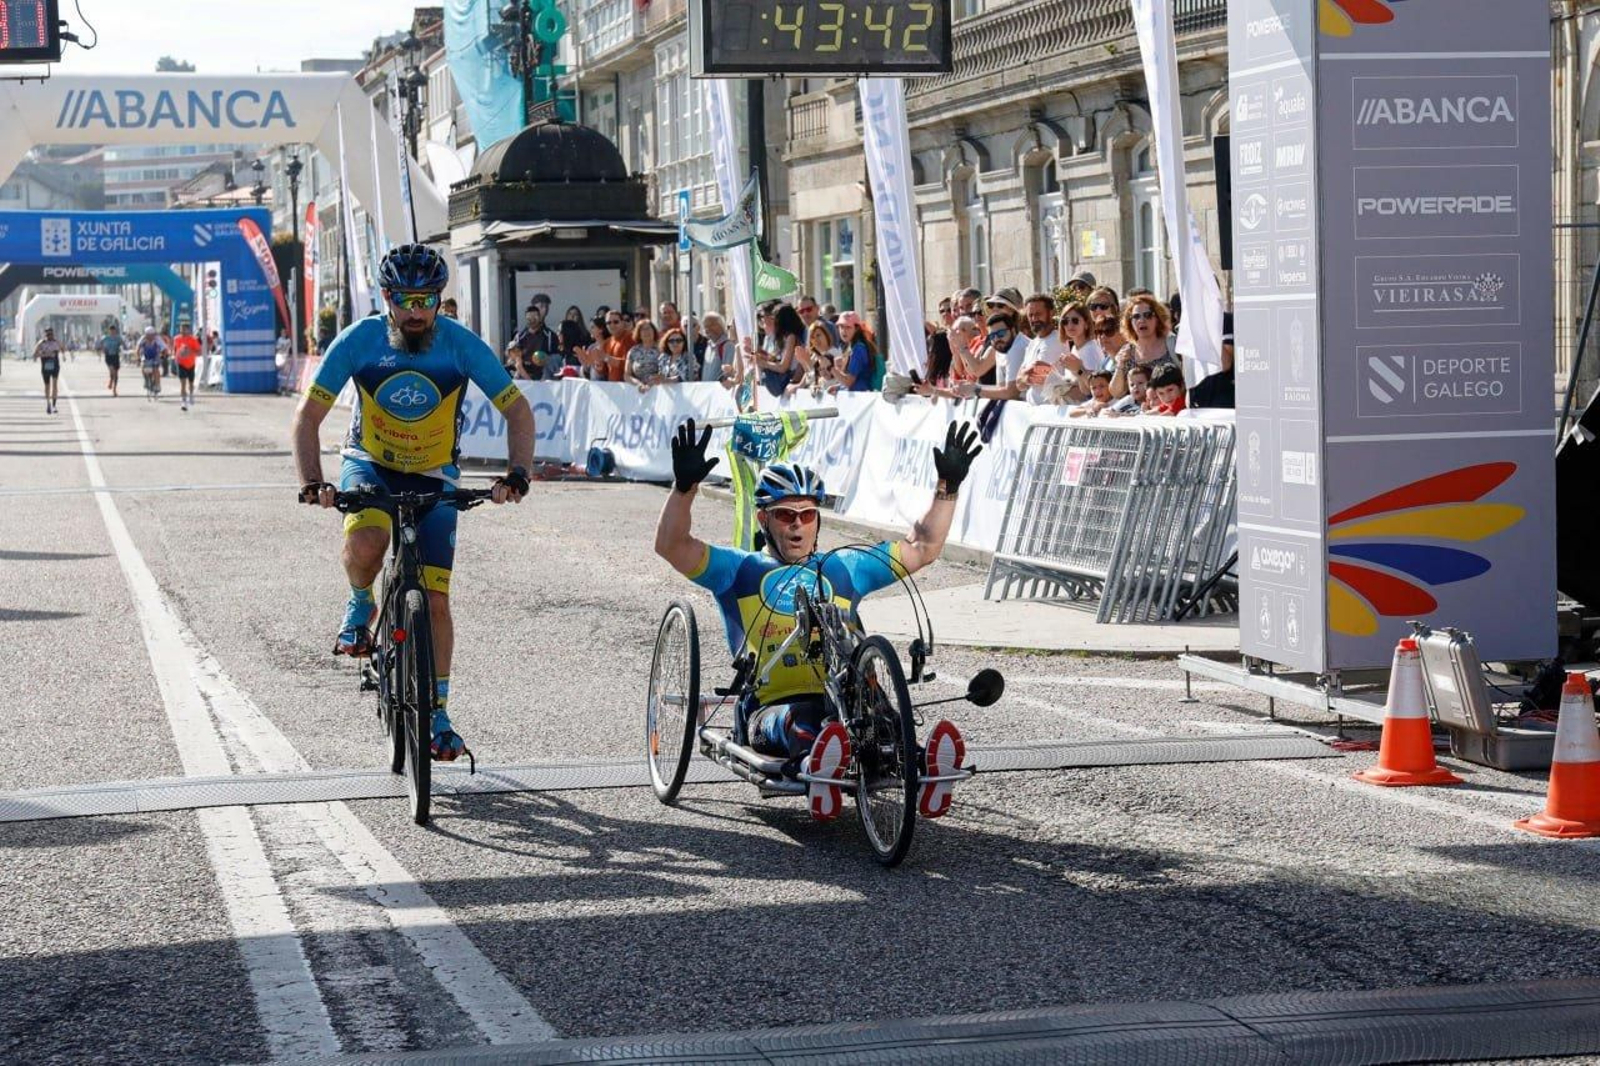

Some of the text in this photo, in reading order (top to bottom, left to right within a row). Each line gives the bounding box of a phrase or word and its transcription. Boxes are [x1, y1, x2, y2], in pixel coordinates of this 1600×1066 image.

[1358, 195, 1517, 216] POWERADE
[77, 221, 131, 235] XUNTA
[77, 236, 165, 251] DE GALICIA
[43, 266, 128, 278] POWERADE
[1373, 287, 1478, 303] VIEIRASA
[1423, 357, 1511, 375] DEPORTE
[1424, 381, 1503, 398] GALEGO
[384, 429, 418, 441] ribera
